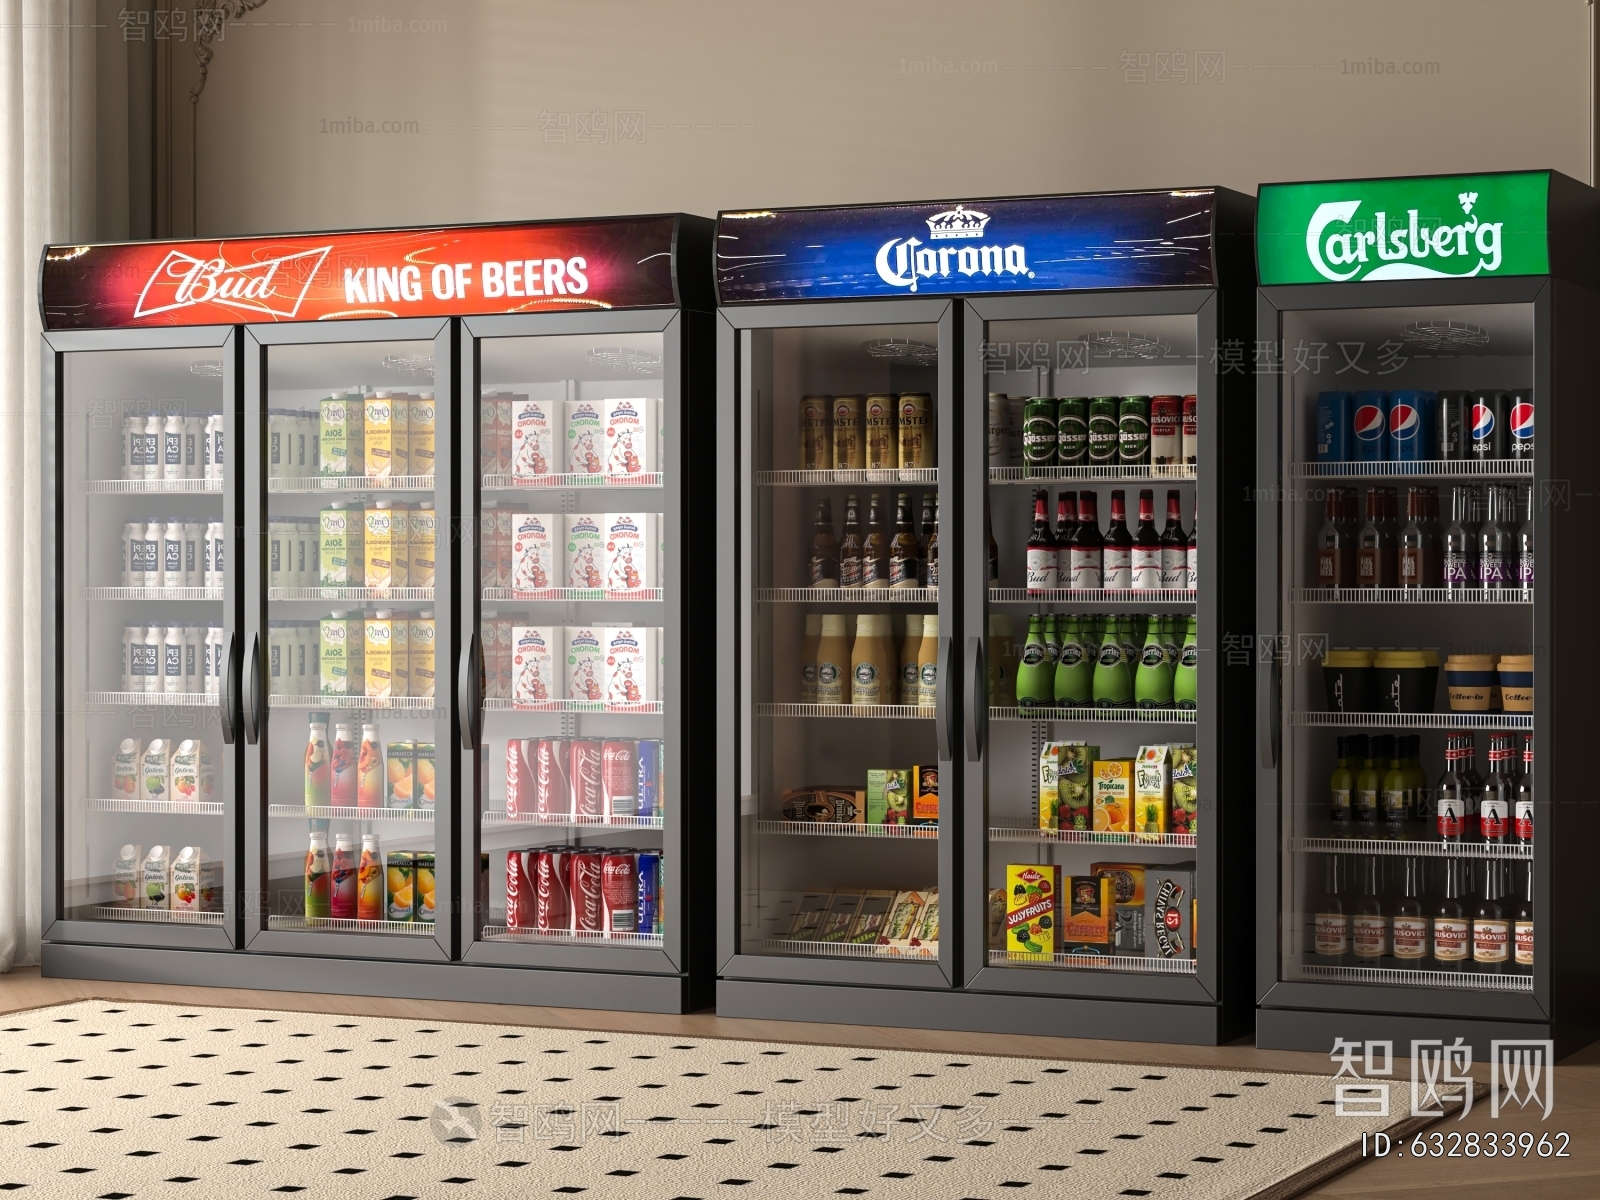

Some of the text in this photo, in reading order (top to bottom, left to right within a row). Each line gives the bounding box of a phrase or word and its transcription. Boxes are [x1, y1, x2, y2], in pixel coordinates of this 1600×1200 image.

[1306, 199, 1504, 282] Carlsberg
[875, 236, 1030, 293] Corona
[166, 258, 277, 303] Bud
[343, 256, 589, 304] KING OF BEERS
[833, 418, 858, 426] MSTE
[866, 417, 897, 426] MSTEL
[899, 416, 929, 426] MSTEL
[1151, 414, 1181, 423] RUŠOVICE
[1472, 441, 1491, 453] epsi
[1511, 442, 1534, 453] peps
[1444, 568, 1466, 579] IPA
[1480, 568, 1503, 579] IPA
[1519, 568, 1534, 579] IP
[1097, 781, 1125, 791] Tropicana
[1441, 806, 1459, 824] A
[1484, 808, 1503, 825] A
[1315, 926, 1346, 934] RUŠOVICE
[1394, 929, 1426, 937] RUŠOVICE
[1434, 930, 1467, 939] RUŠOVICE
[1474, 932, 1506, 941] RUŠOVICE
